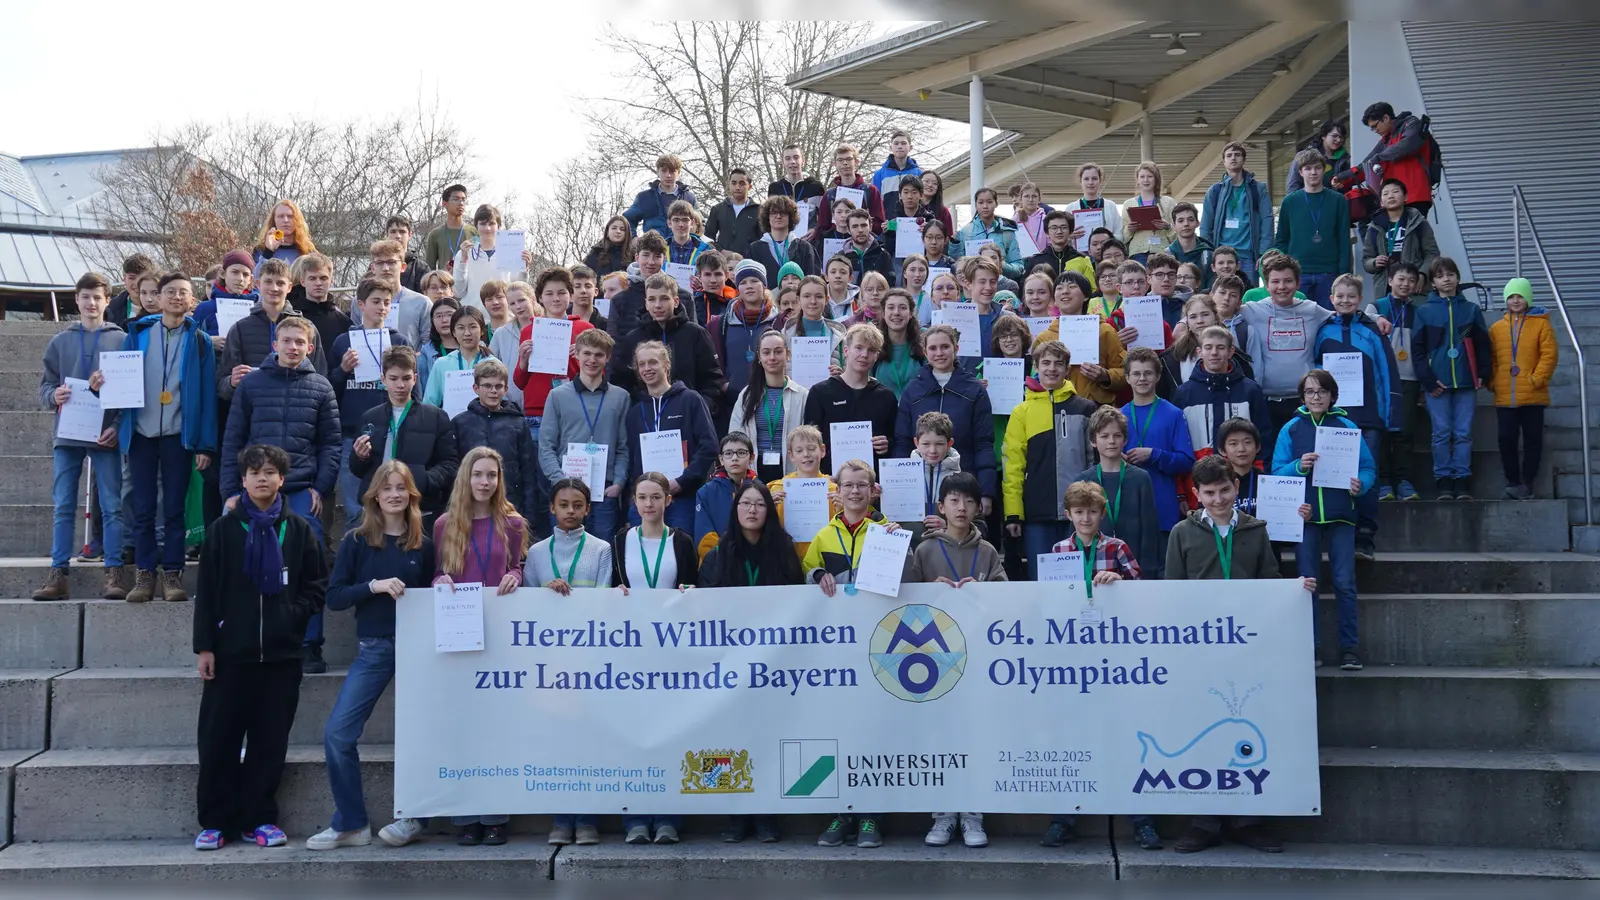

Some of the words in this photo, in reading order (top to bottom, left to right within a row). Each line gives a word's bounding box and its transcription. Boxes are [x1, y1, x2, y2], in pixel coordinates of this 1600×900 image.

[511, 620, 642, 647] Herzlich
[653, 619, 857, 647] Willkommen
[987, 620, 1034, 645] 64.
[1045, 616, 1258, 645] Mathematik-
[475, 668, 527, 690] zur
[536, 662, 738, 690] Landesrunde
[748, 663, 858, 696] Bayern
[989, 657, 1167, 694] Olympiade
[848, 753, 968, 770] UNIVERSITÄT
[438, 766, 519, 780] Bayerisches
[524, 765, 644, 779] Staatsministerium
[647, 766, 666, 779] für
[848, 772, 944, 787] BAYREUTH
[1012, 766, 1058, 778] Institut
[1061, 765, 1079, 778] für
[525, 780, 591, 792] Unterricht
[596, 780, 621, 792] und
[625, 780, 666, 793] Kultus
[995, 781, 1098, 793] MATHEMATIK
[1133, 768, 1270, 795] MOBY
